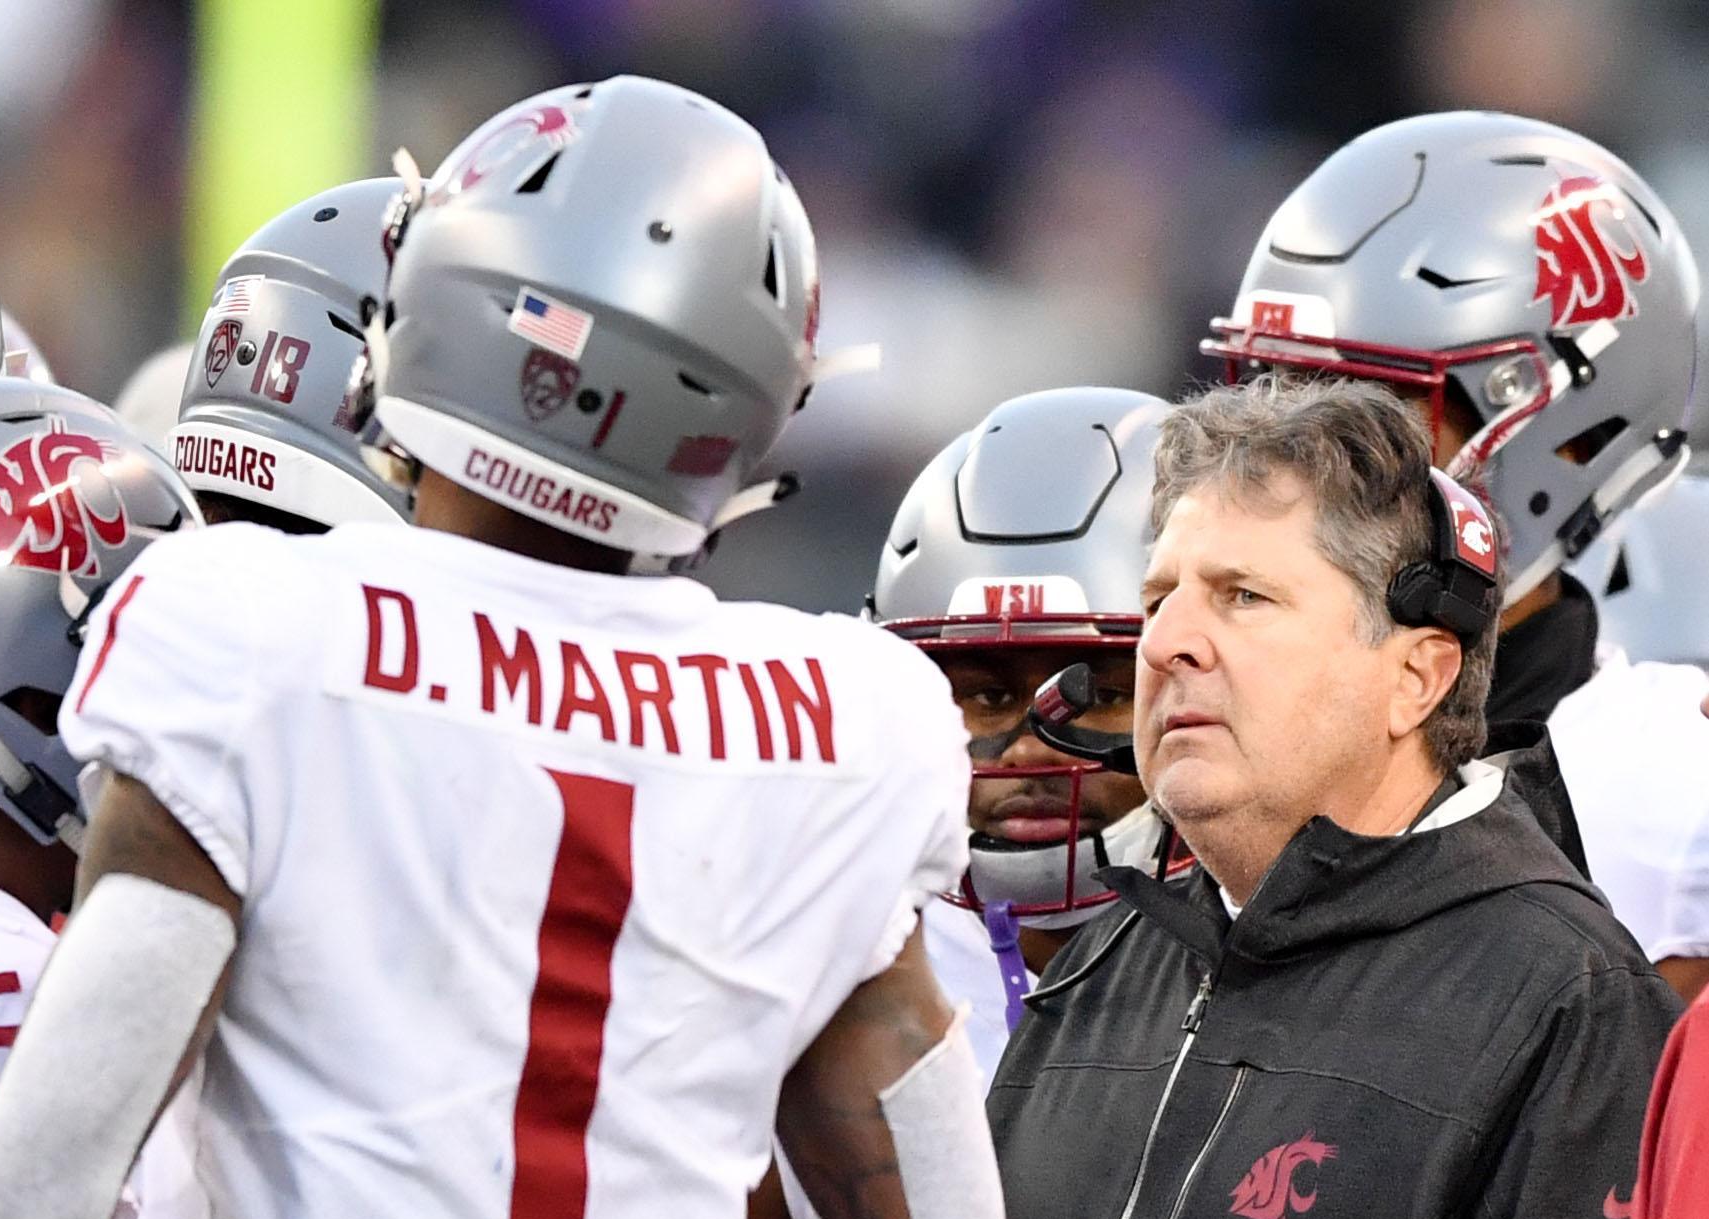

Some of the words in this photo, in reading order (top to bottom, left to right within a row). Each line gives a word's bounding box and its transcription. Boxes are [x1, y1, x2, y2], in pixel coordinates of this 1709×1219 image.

[250, 330, 311, 405] 18
[174, 434, 276, 492] COUGARS
[464, 448, 621, 532] COUGARS
[983, 584, 1044, 616] WSU
[362, 584, 447, 703] D.
[473, 611, 837, 764] MARTIN
